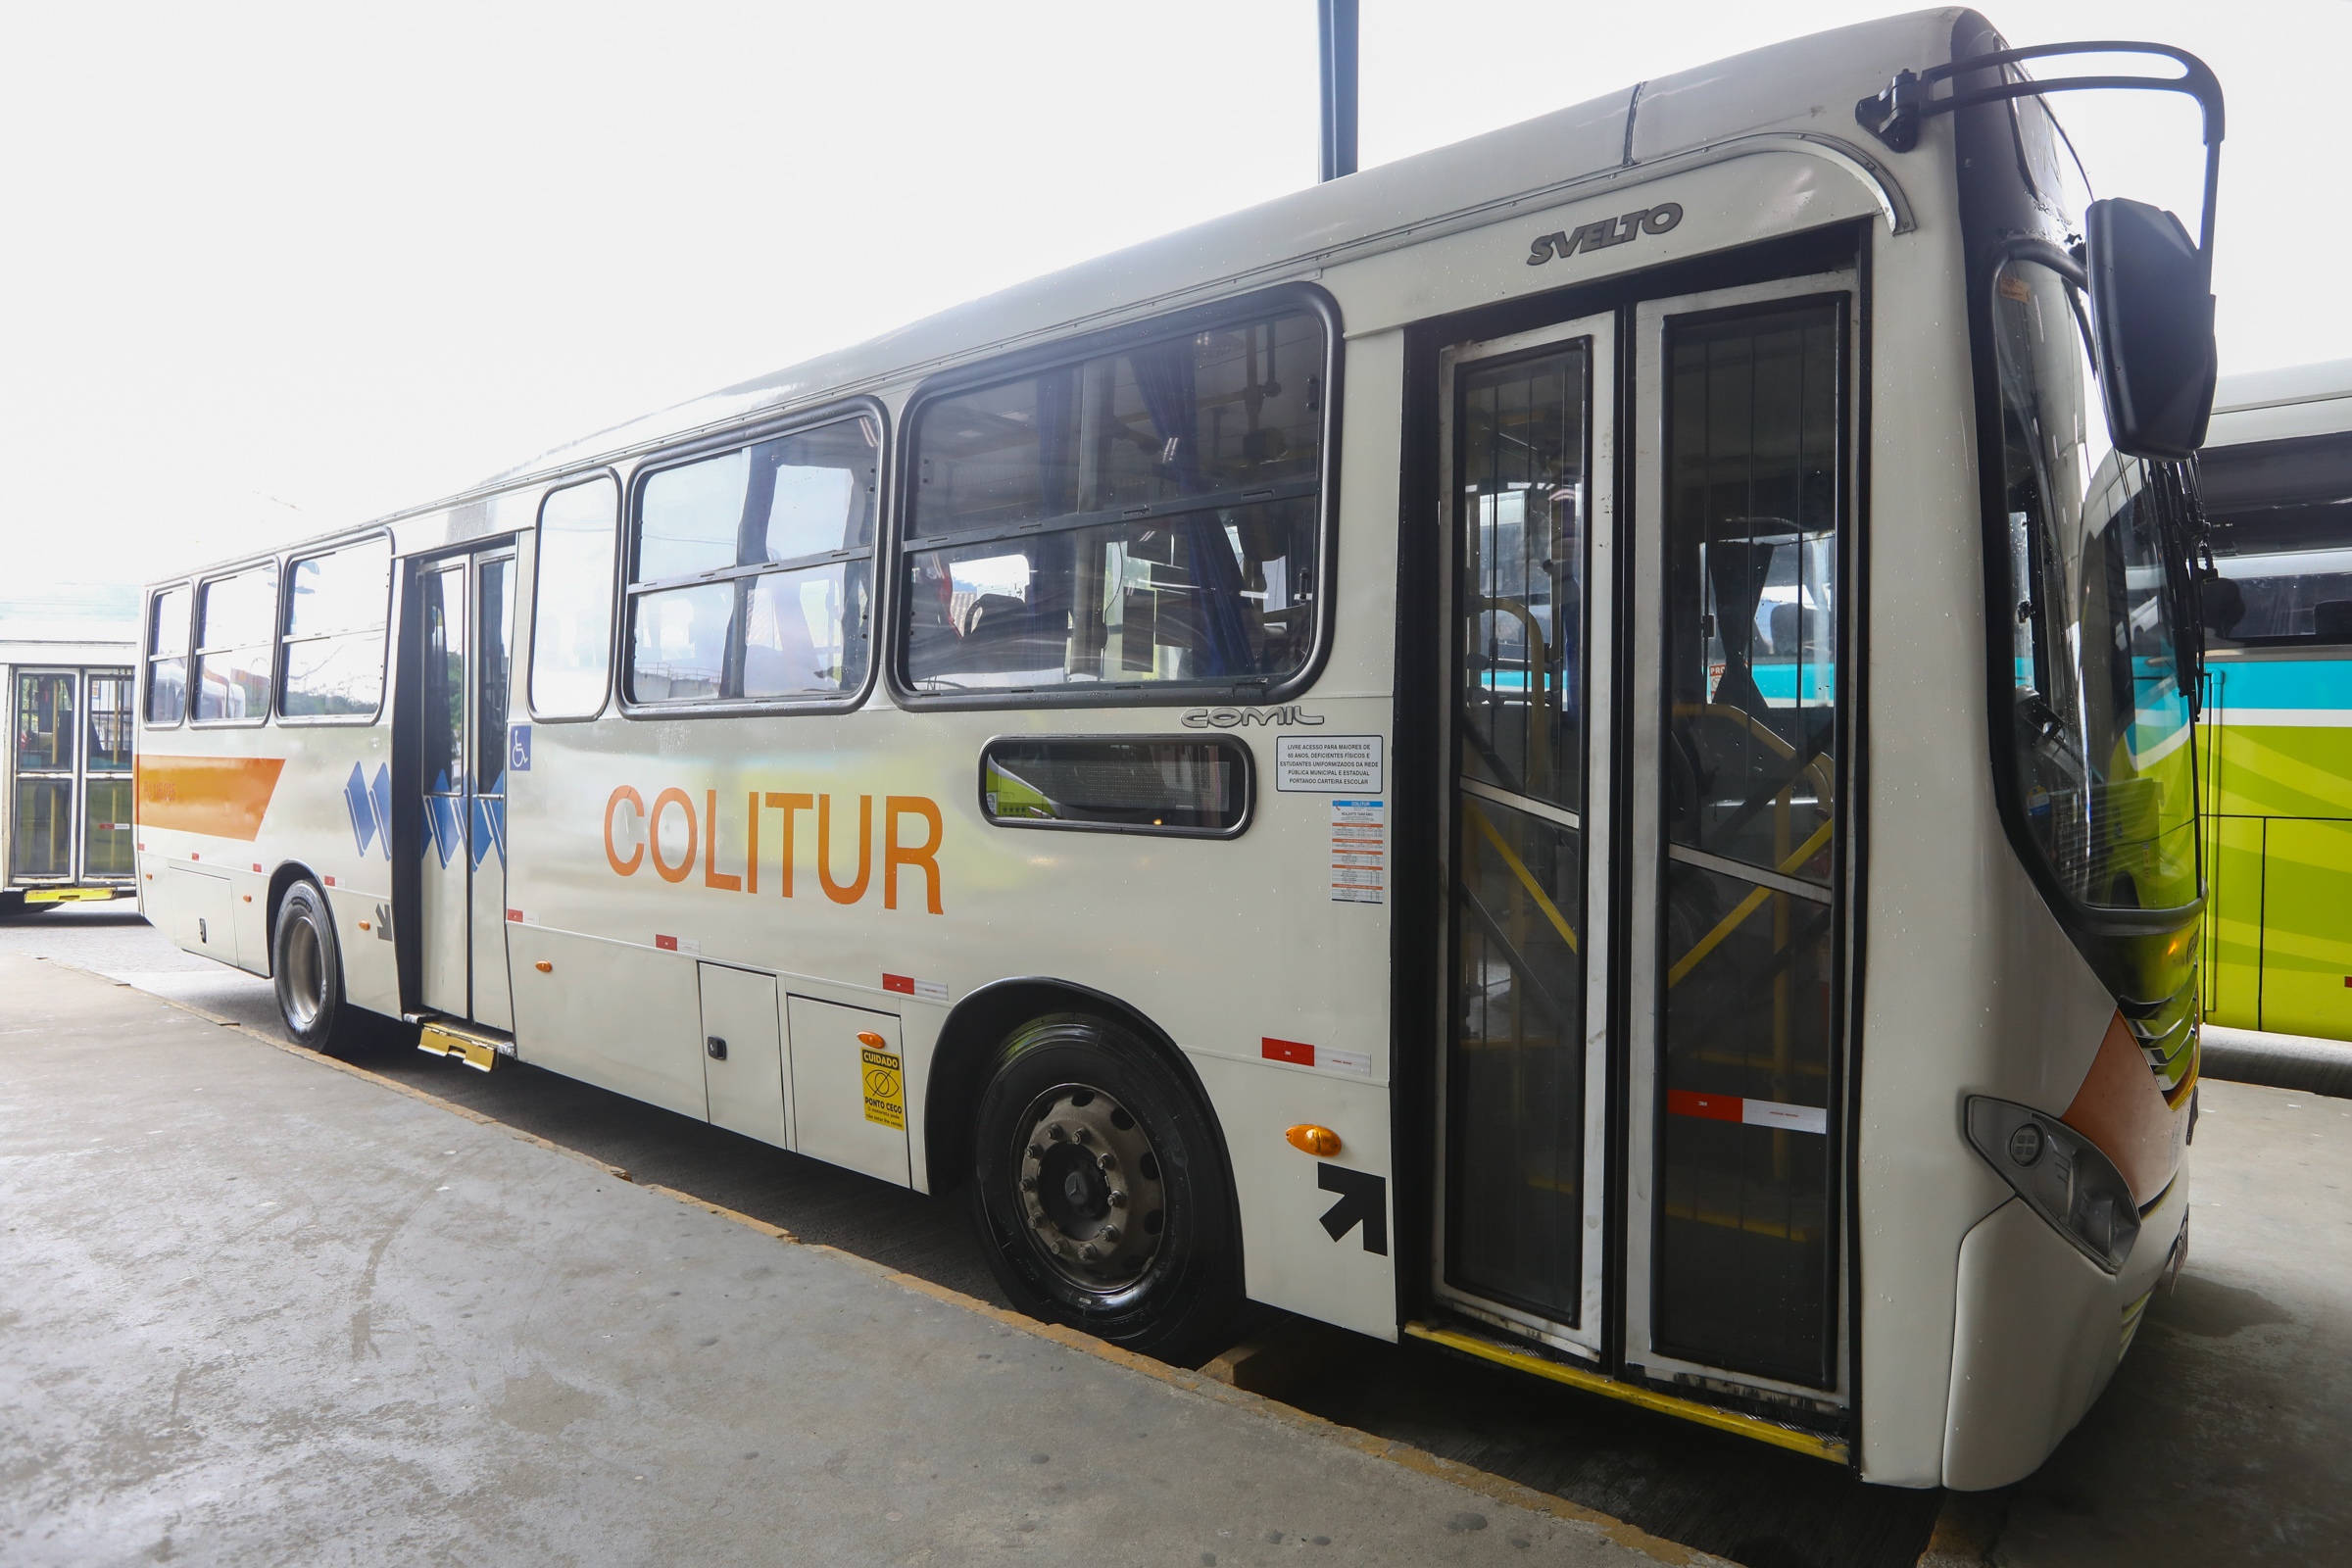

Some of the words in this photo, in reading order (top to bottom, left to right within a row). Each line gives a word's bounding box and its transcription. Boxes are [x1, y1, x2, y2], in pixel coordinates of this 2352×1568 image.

[1526, 202, 1684, 267] SVELTO
[1180, 706, 1325, 728] COMIL
[604, 785, 944, 915] COLITUR
[863, 1052, 898, 1068] CUIDADO
[865, 1097, 885, 1108] PONTO
[886, 1102, 902, 1113] CEGO
